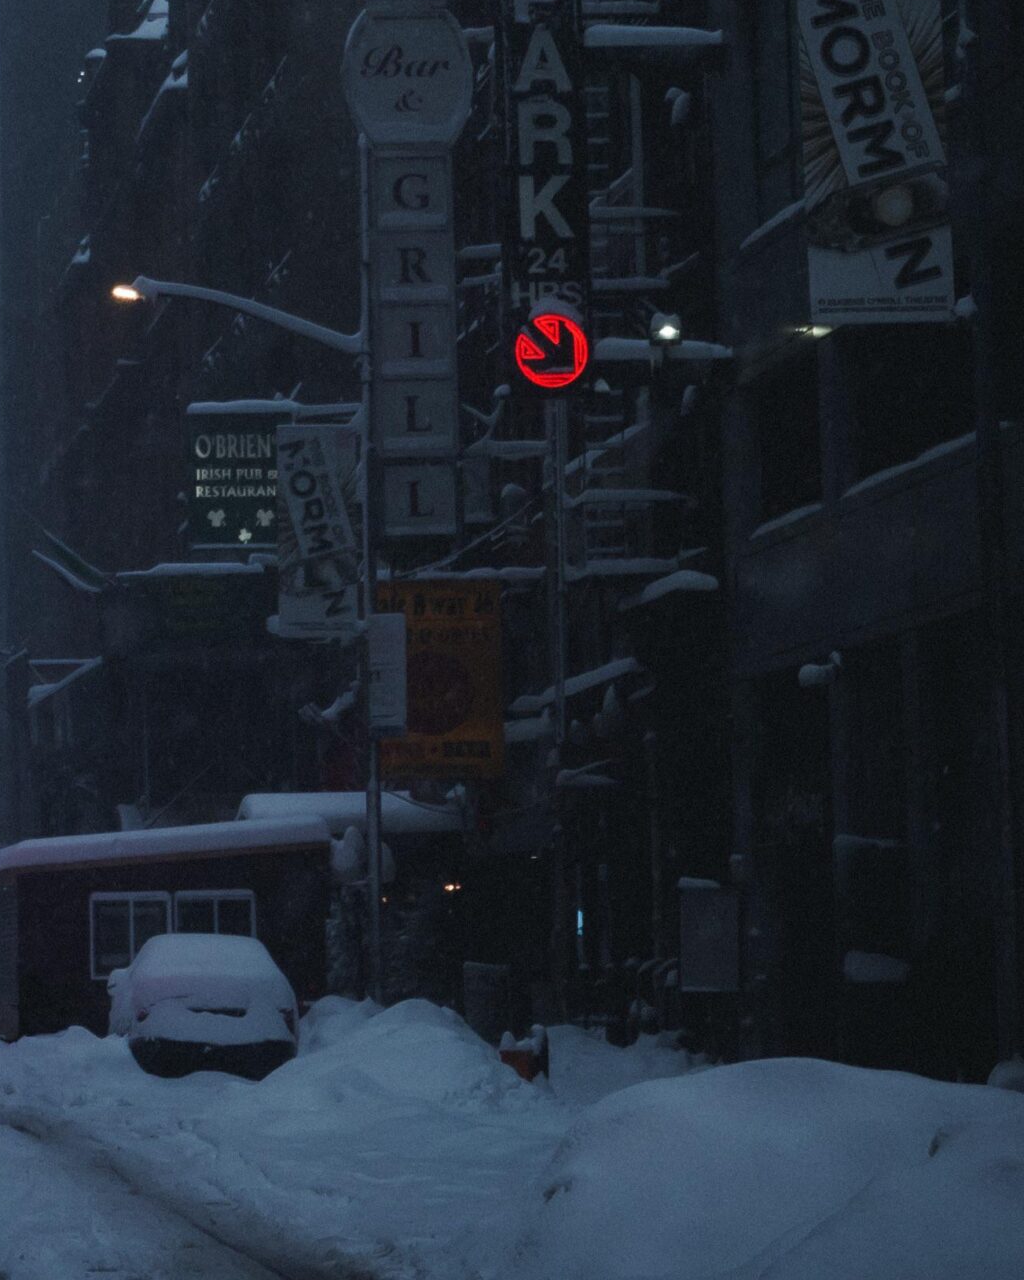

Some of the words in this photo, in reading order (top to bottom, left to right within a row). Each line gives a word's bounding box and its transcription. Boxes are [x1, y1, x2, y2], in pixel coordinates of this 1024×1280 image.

[360, 44, 449, 78] Bar
[395, 88, 423, 112] &
[872, 30, 915, 115] BOOK
[901, 120, 931, 159] OF
[527, 247, 570, 273] 24
[511, 281, 582, 308] HRS
[393, 174, 433, 517] GRILL
[196, 468, 231, 481] IRISH
[236, 468, 262, 480] PUB
[195, 485, 277, 498] RESTAURAN
